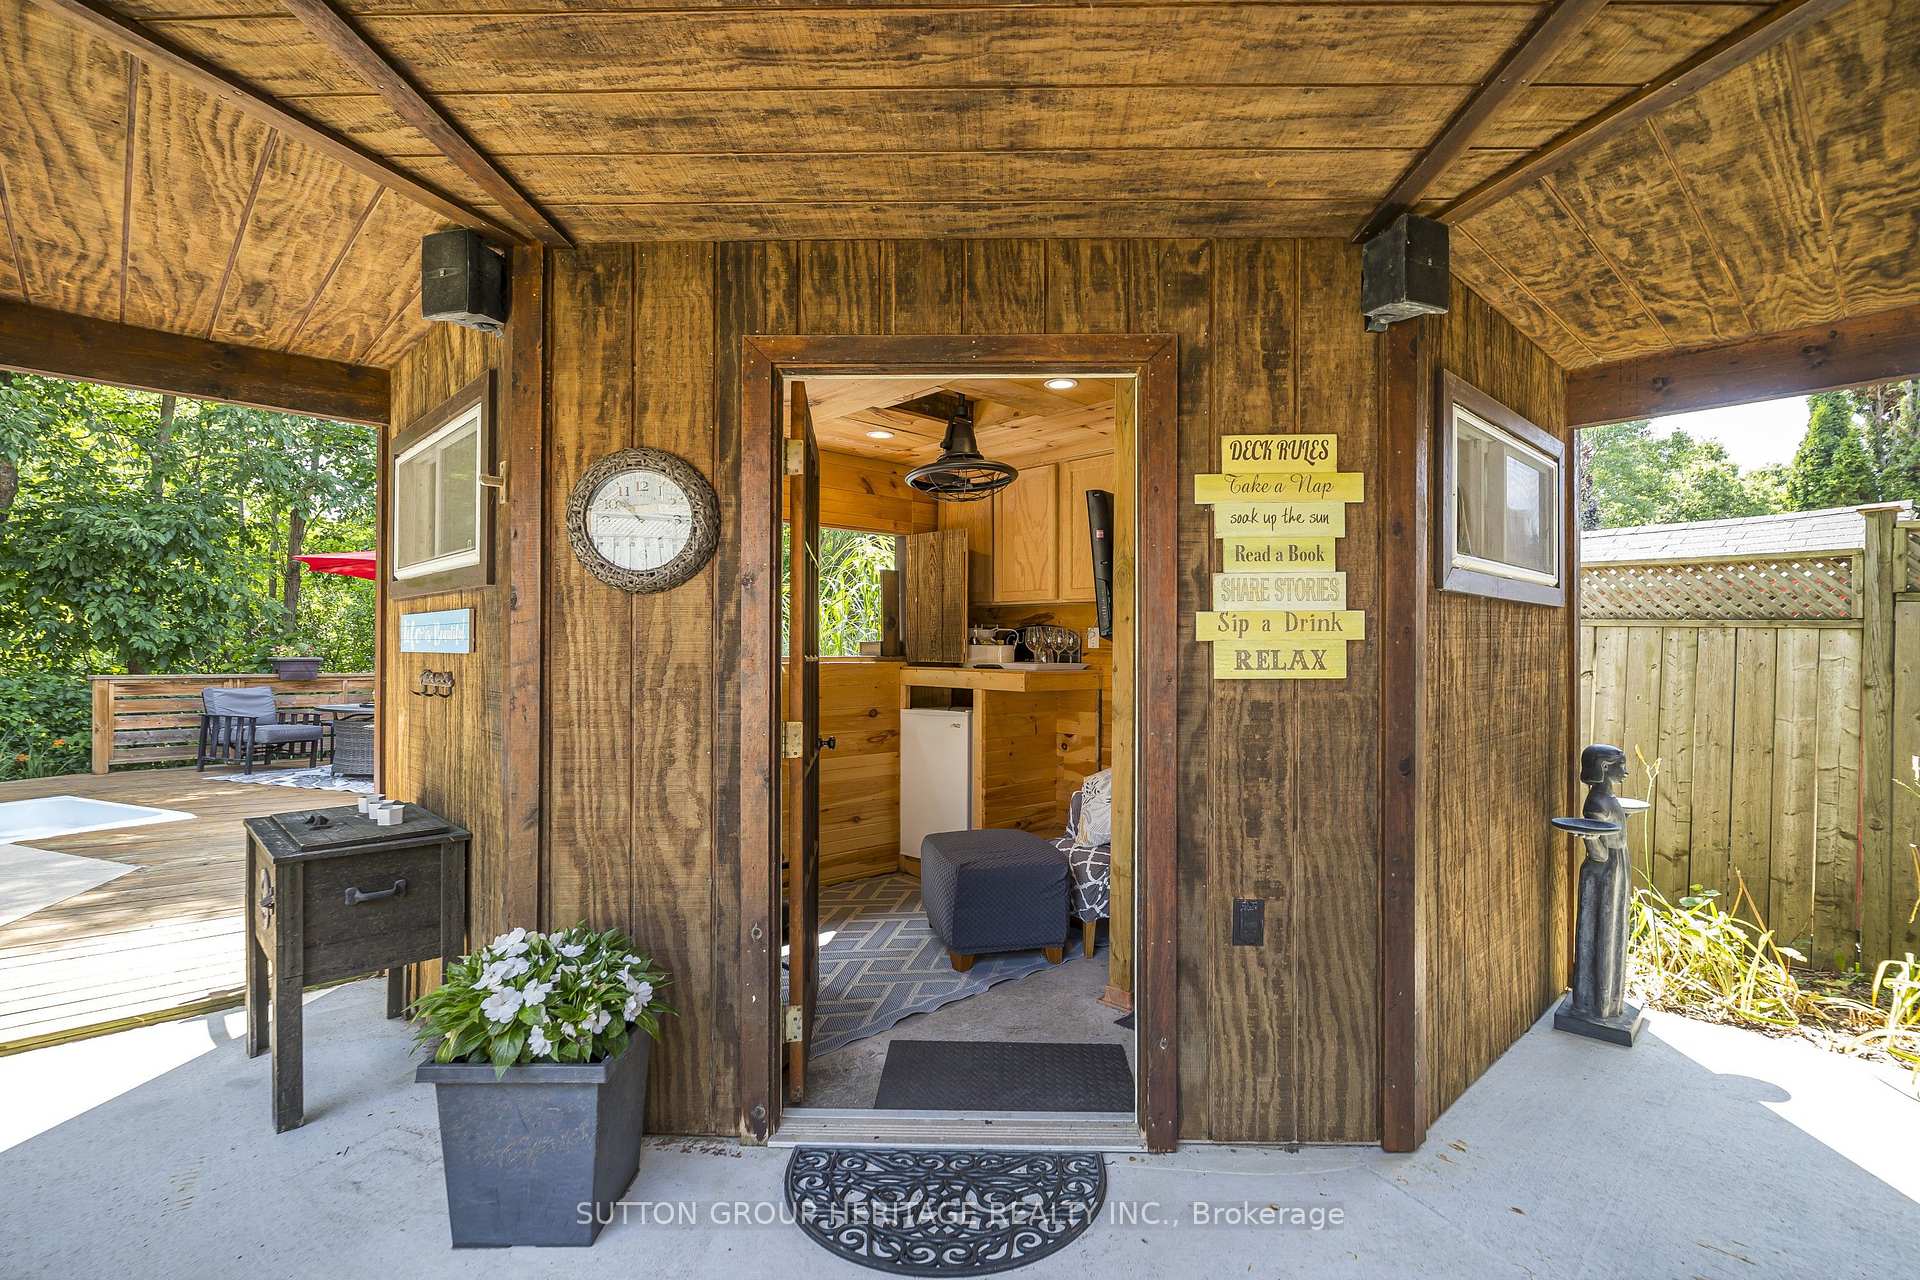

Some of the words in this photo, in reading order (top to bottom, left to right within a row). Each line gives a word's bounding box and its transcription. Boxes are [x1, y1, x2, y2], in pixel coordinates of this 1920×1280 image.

[1230, 439, 1273, 461] DECK
[1276, 439, 1330, 466] RULES
[618, 486, 629, 497] 11
[635, 481, 649, 492] 12
[1224, 473, 1272, 494] Take
[1274, 483, 1285, 494] a
[1290, 472, 1335, 499] Nap
[1230, 506, 1258, 525] soak
[1263, 513, 1277, 531] up
[1281, 506, 1305, 525] the
[1309, 513, 1330, 525] sun
[1235, 544, 1271, 562] Read
[1275, 550, 1284, 562] a
[1288, 544, 1325, 562] Book
[1221, 577, 1270, 602] SHARE
[1274, 577, 1340, 602] STORIES
[1217, 611, 1250, 639] Sip
[1261, 619, 1271, 632] a
[1284, 610, 1343, 633] Drink
[1234, 649, 1328, 671] RELAX
